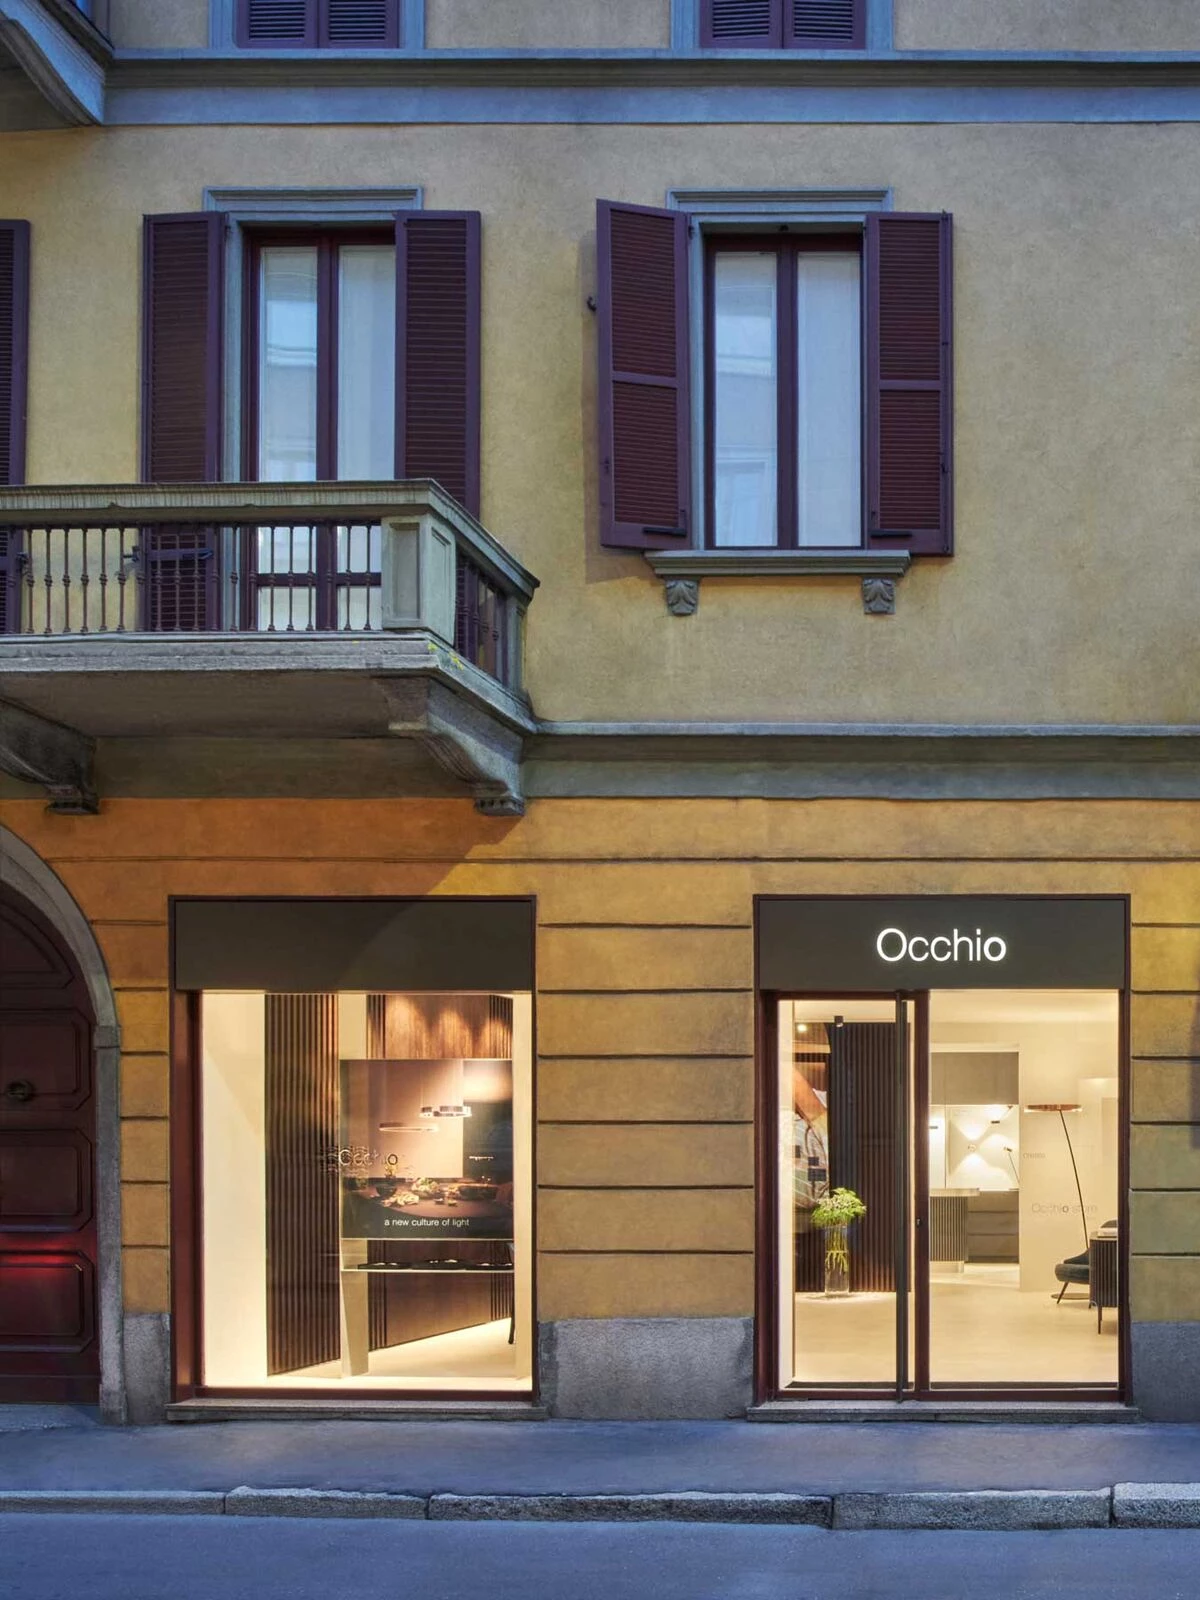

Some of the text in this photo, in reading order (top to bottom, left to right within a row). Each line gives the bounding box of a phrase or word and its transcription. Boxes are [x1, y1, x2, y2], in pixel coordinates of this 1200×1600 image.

[876, 928, 1007, 962] Occhio
[411, 1218, 440, 1226] culture
[441, 1218, 450, 1226] of
[452, 1218, 470, 1228] light
